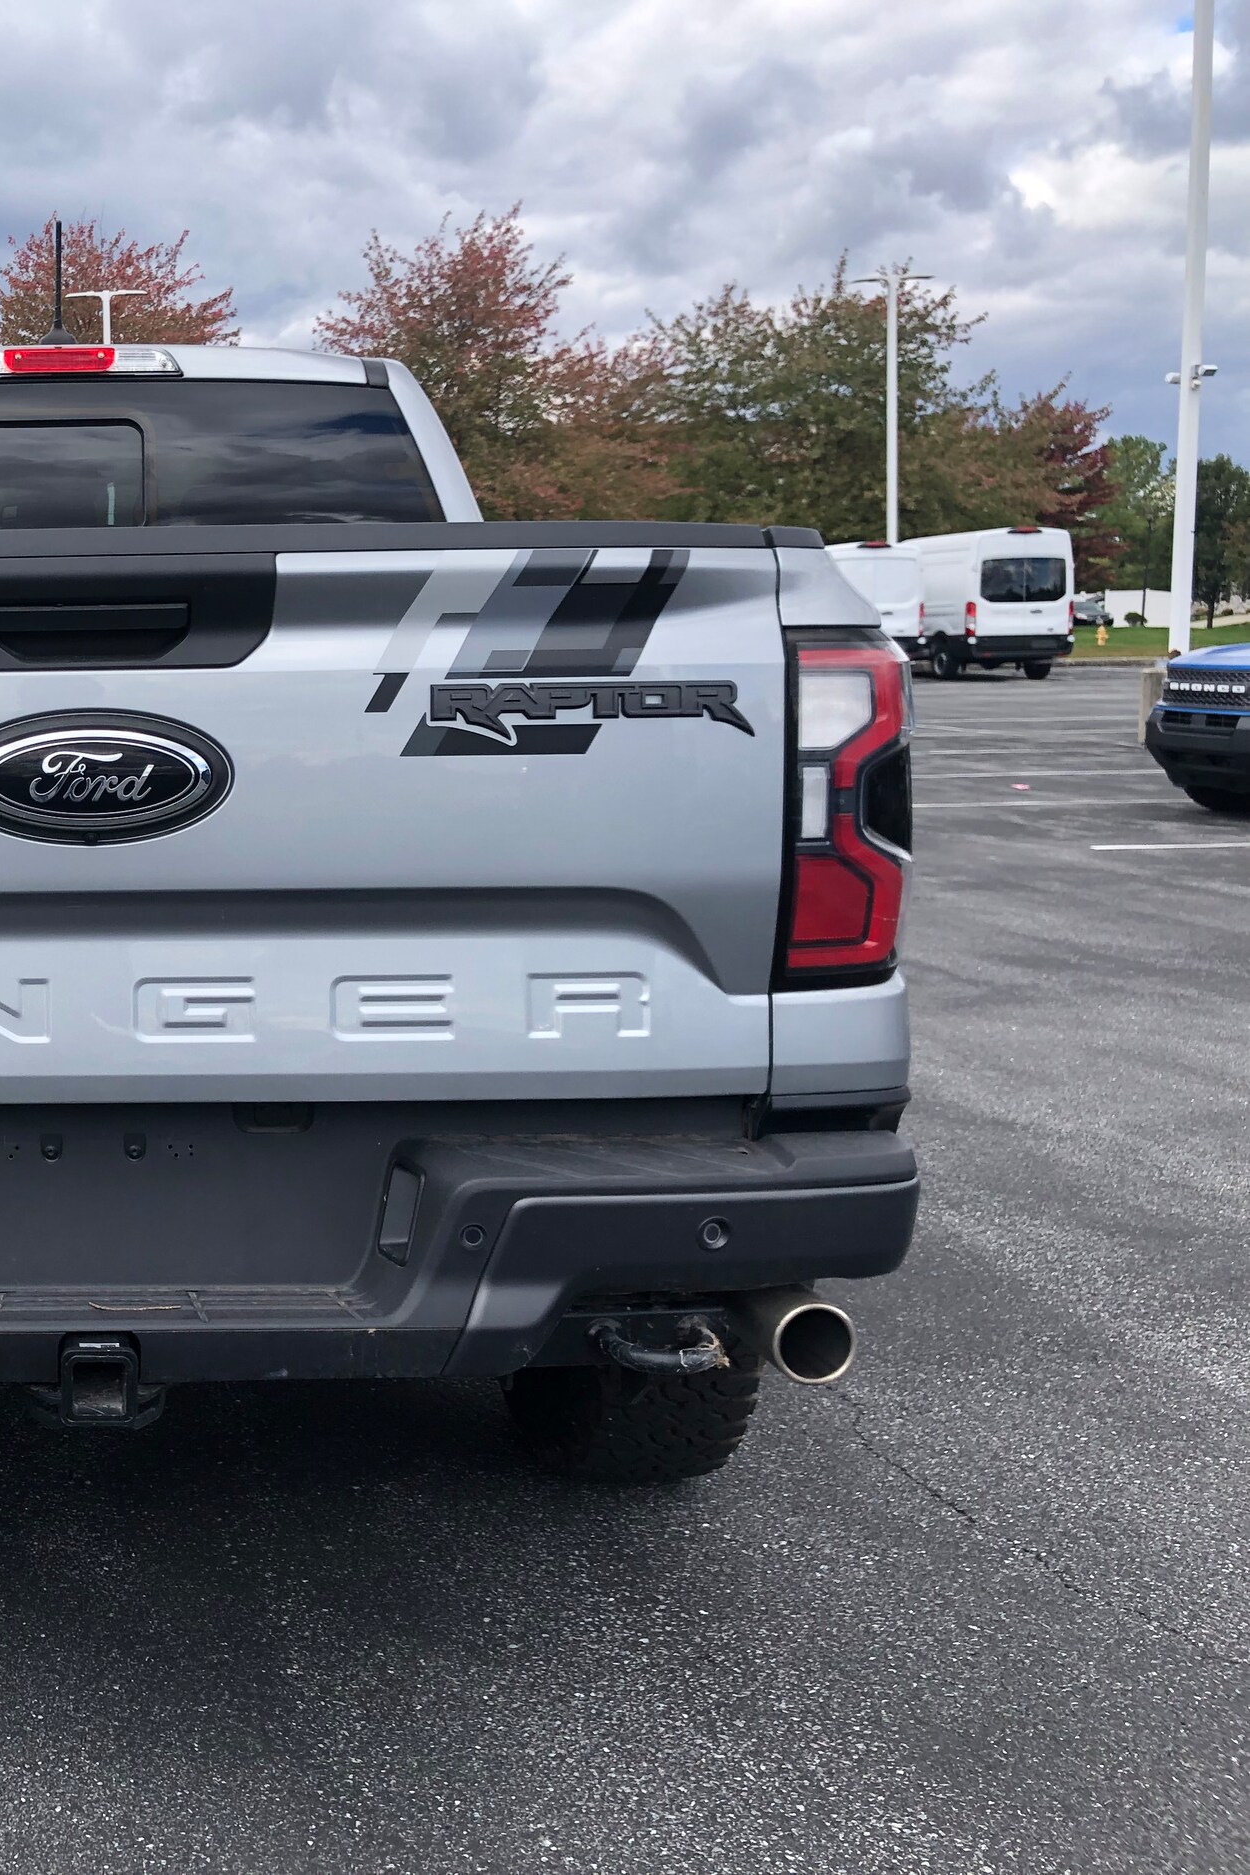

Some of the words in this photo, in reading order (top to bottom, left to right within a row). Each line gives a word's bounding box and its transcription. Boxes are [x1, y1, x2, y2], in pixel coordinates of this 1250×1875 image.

[430, 680, 756, 737] RAPTOR
[1169, 681, 1246, 694] BRONCO
[29, 750, 155, 802] Ford
